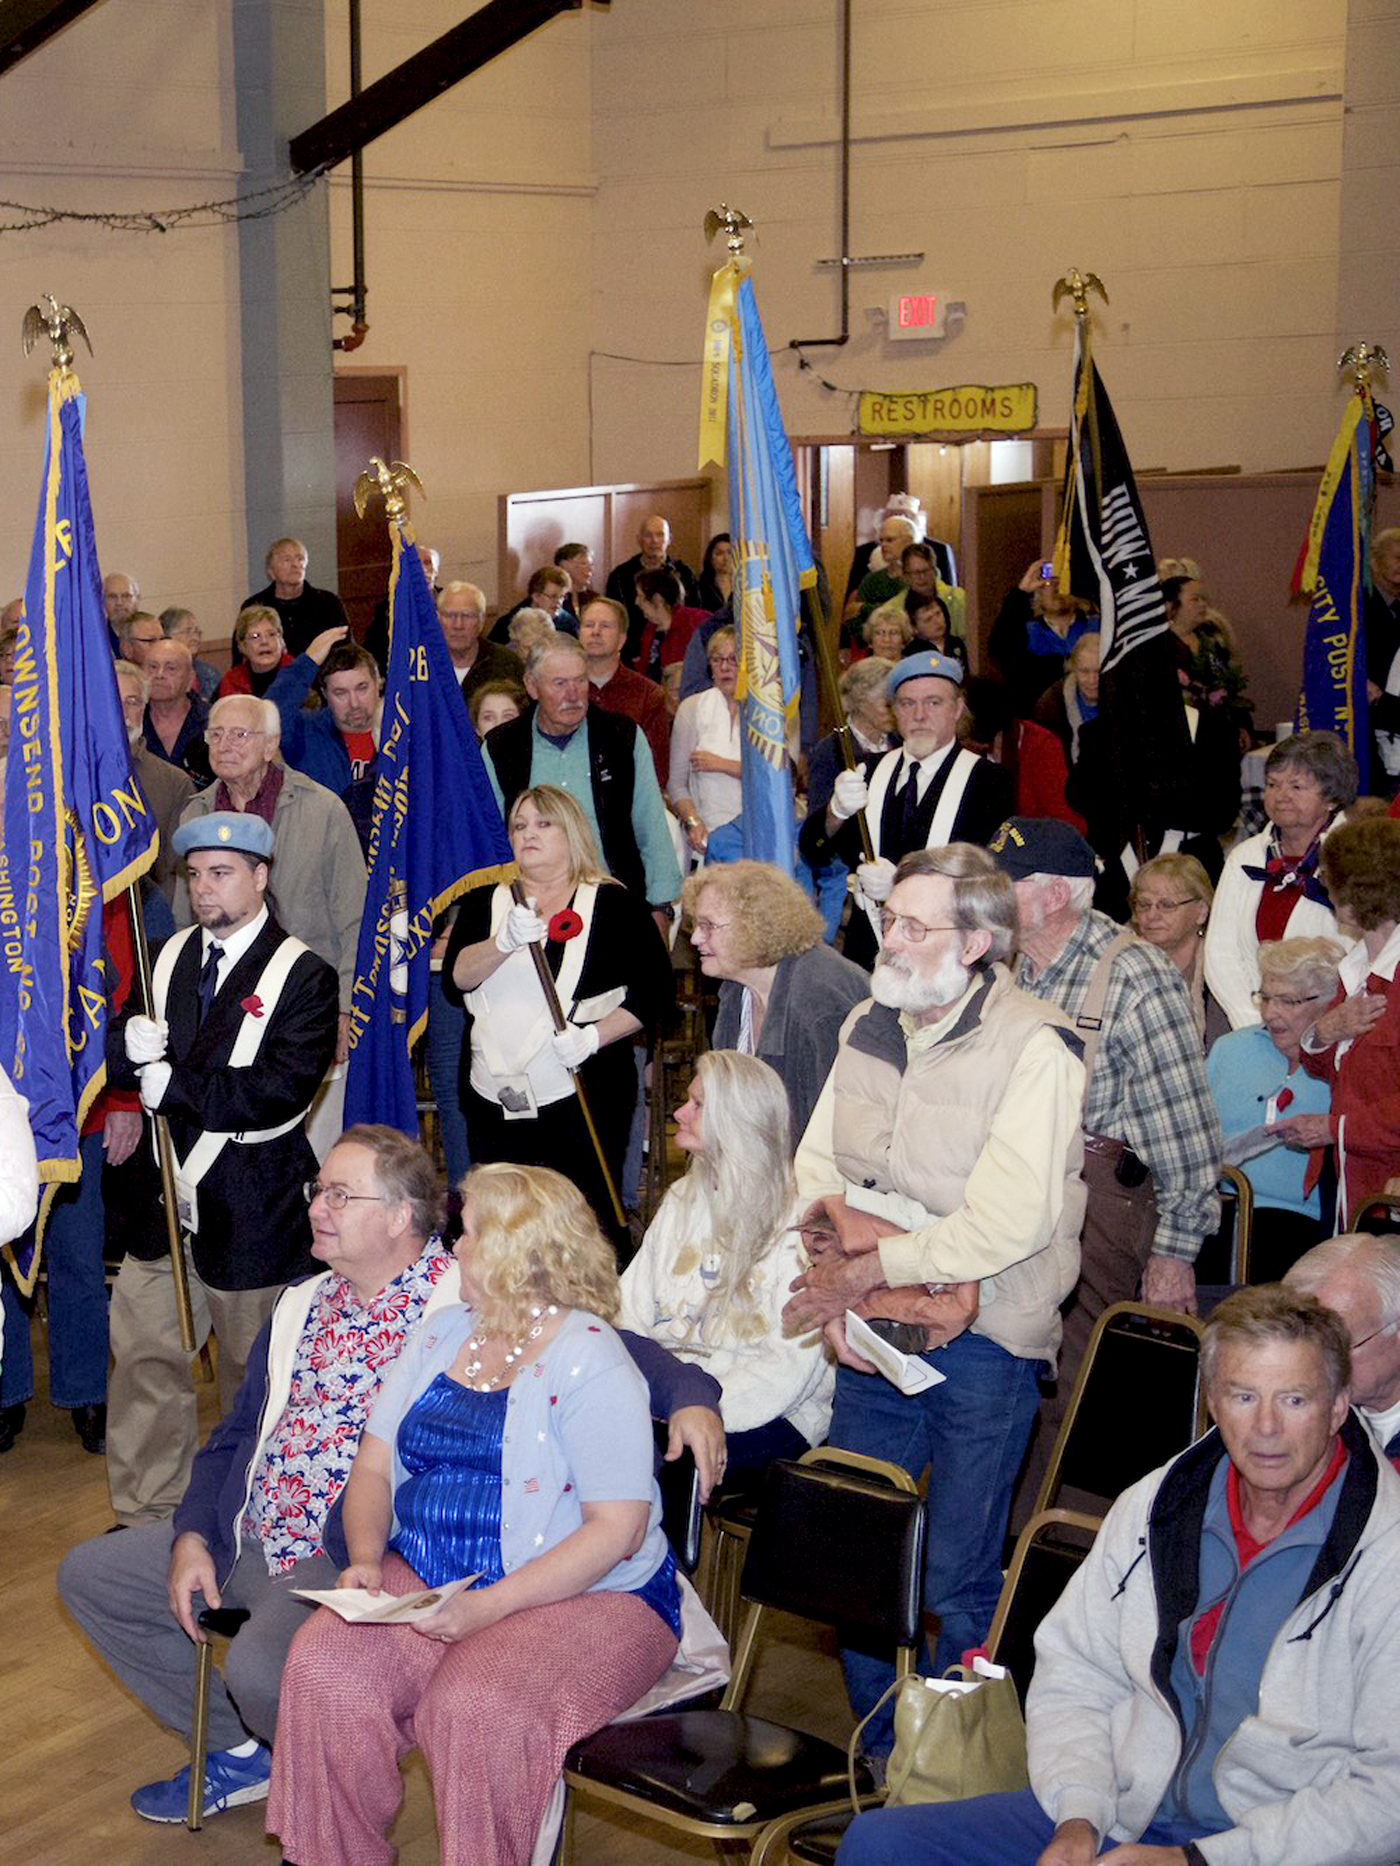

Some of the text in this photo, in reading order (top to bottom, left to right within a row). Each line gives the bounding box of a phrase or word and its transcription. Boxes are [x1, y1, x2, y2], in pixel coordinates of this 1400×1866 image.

[899, 296, 936, 327] EXIT
[871, 396, 1013, 422] RESTROOMS
[1100, 573, 1170, 674] MIA
